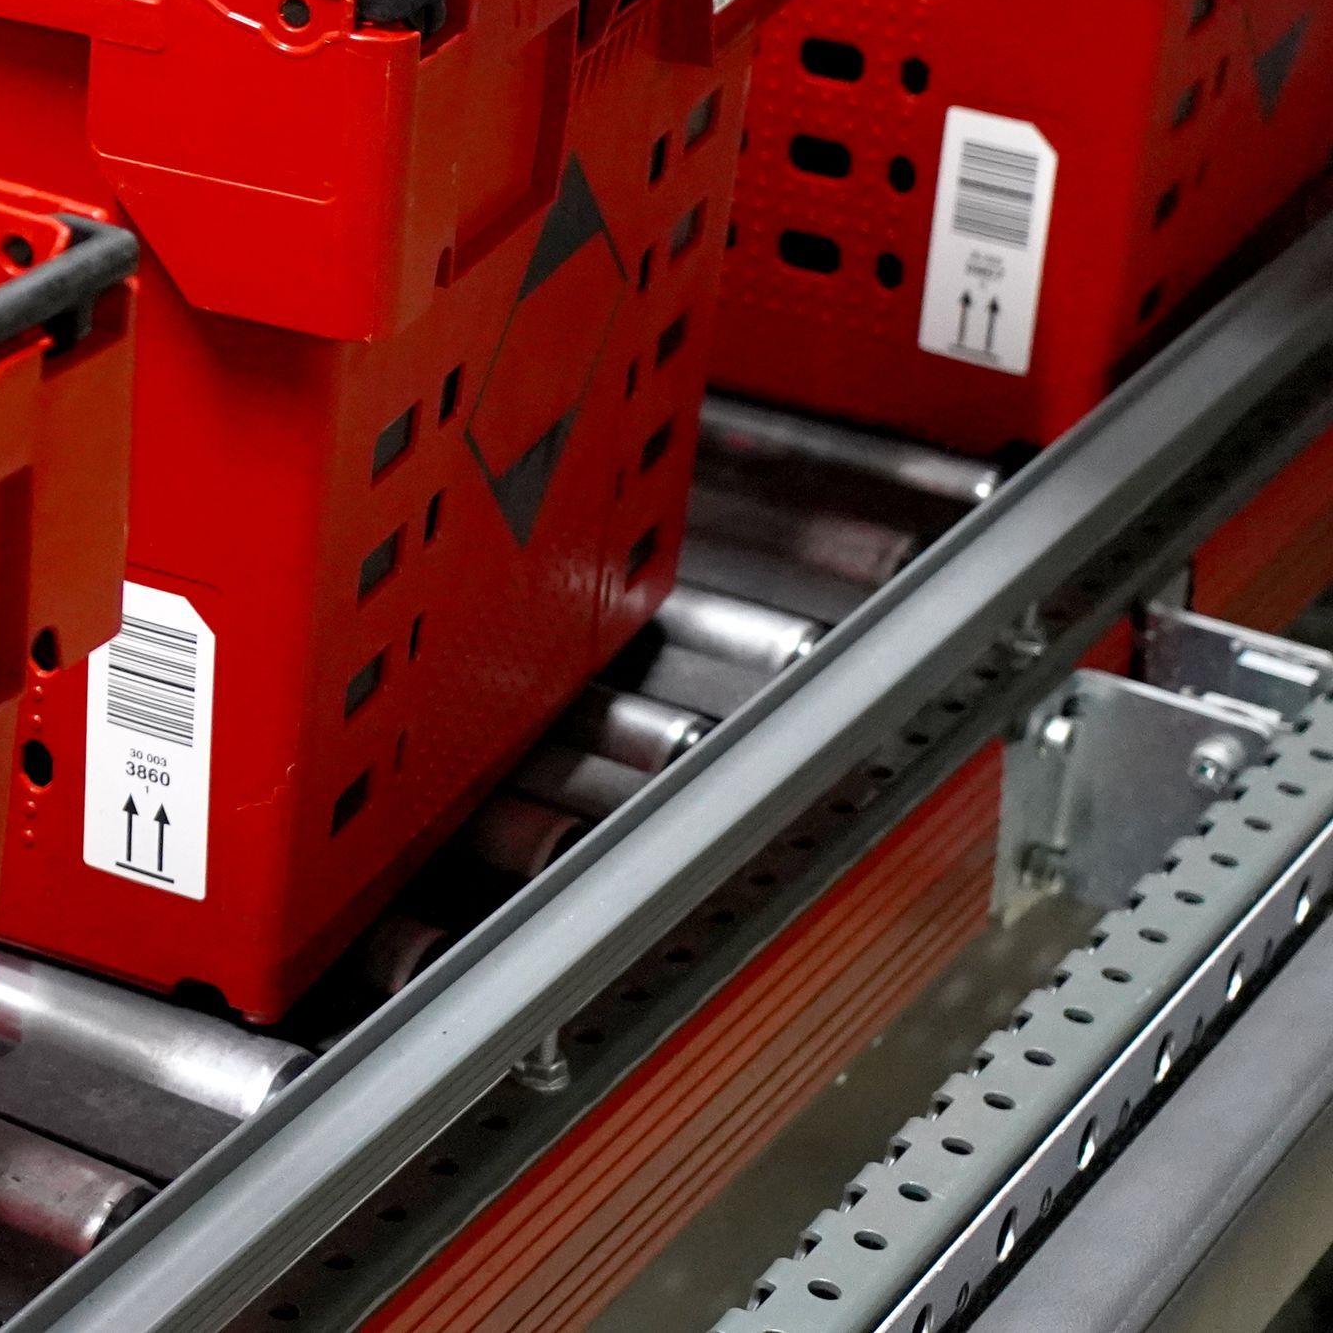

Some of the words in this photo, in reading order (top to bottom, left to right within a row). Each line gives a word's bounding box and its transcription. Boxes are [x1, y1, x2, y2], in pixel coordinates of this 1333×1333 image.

[130, 748, 143, 760] 30
[146, 753, 167, 766] 003
[126, 761, 170, 786] 3860
